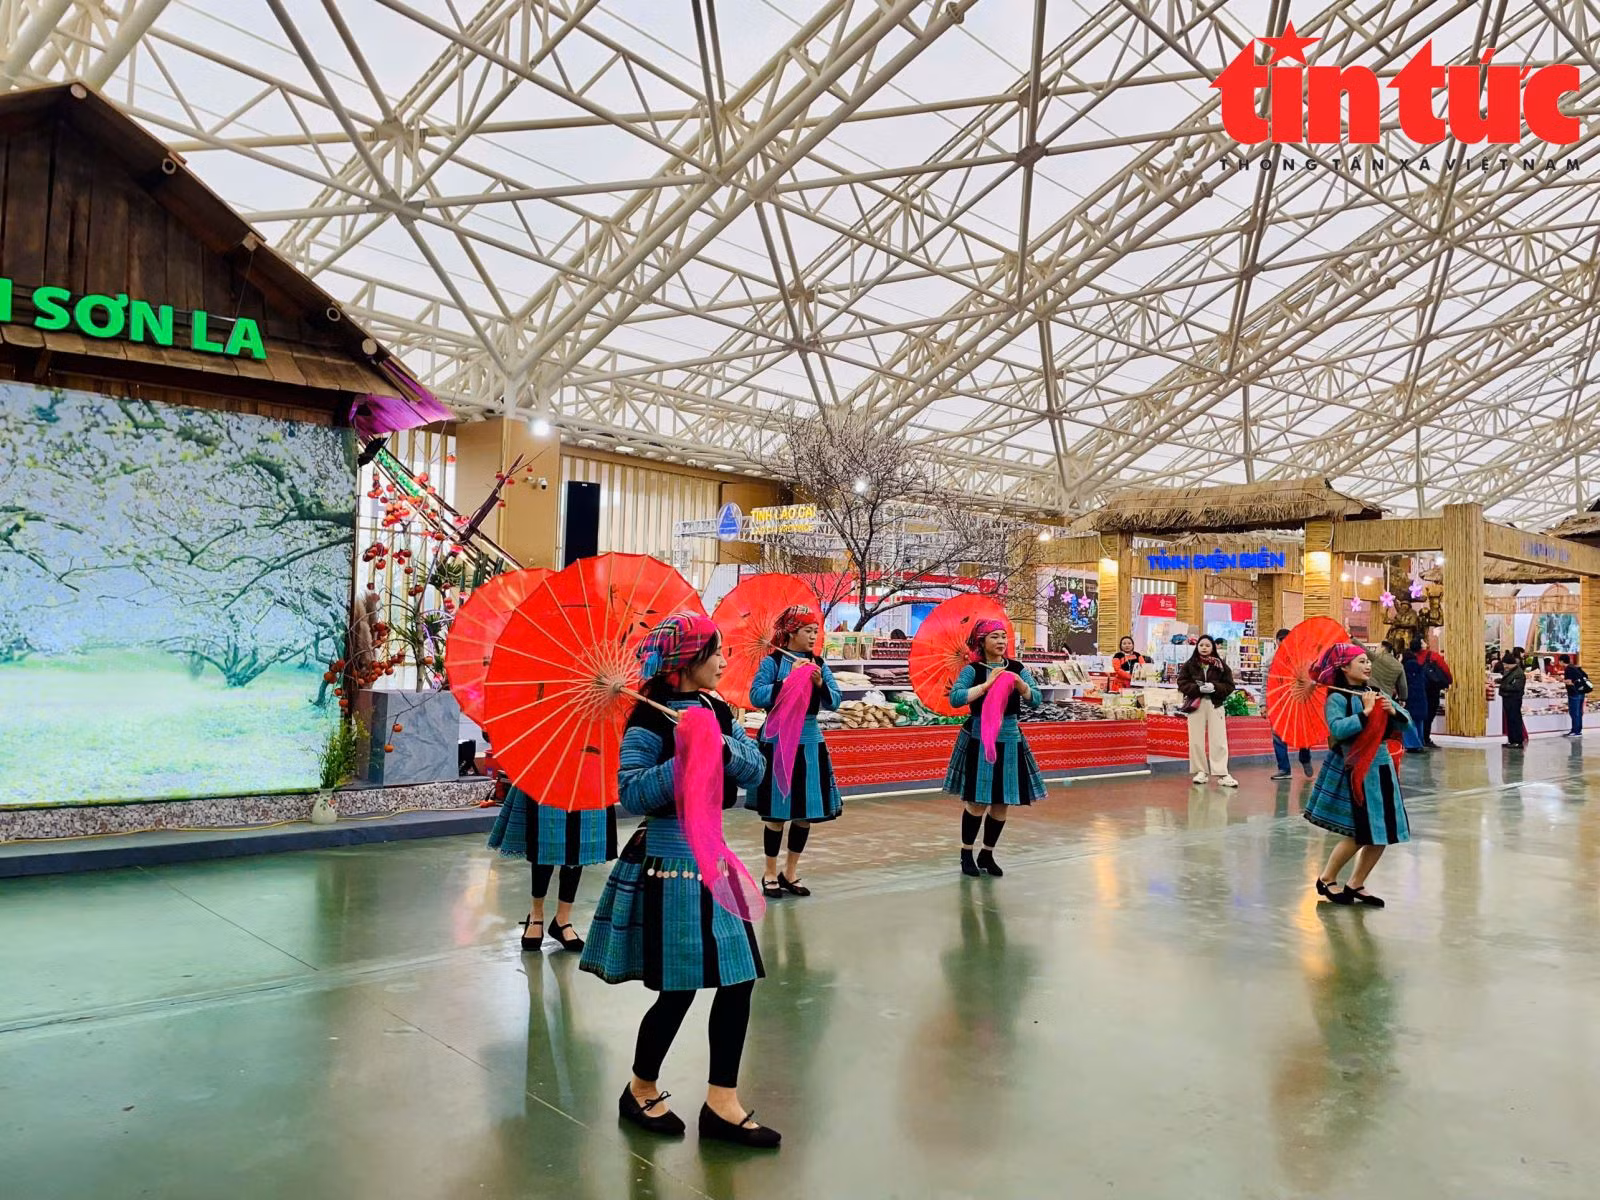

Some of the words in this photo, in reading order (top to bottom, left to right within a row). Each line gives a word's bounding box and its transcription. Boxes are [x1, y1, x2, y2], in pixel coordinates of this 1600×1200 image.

[32, 285, 174, 346] SƠN
[191, 310, 267, 360] LA
[1147, 549, 1191, 571] TỈNH
[1192, 548, 1238, 573] ĐIỆN
[1239, 545, 1287, 569] BIÊN
